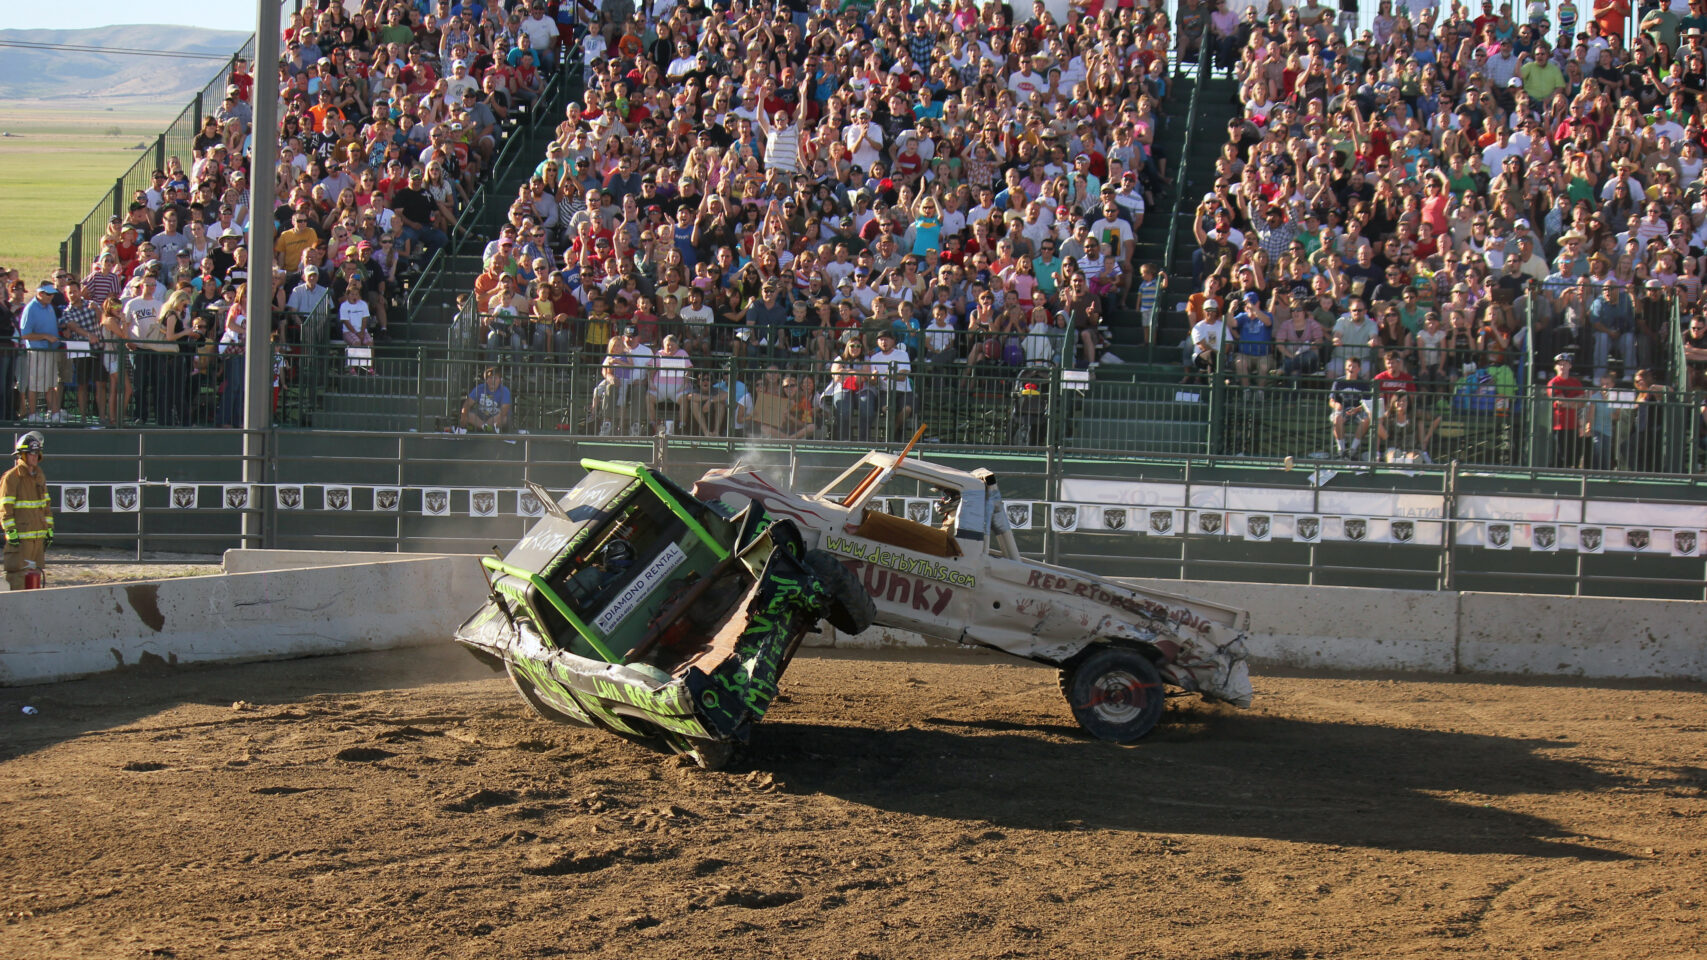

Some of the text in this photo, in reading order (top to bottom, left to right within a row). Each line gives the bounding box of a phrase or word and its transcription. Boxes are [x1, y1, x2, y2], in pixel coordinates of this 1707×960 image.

[319, 142, 335, 158] 45
[604, 548, 679, 621] DIAMOND RENTAL
[1027, 569, 1068, 590] RED
